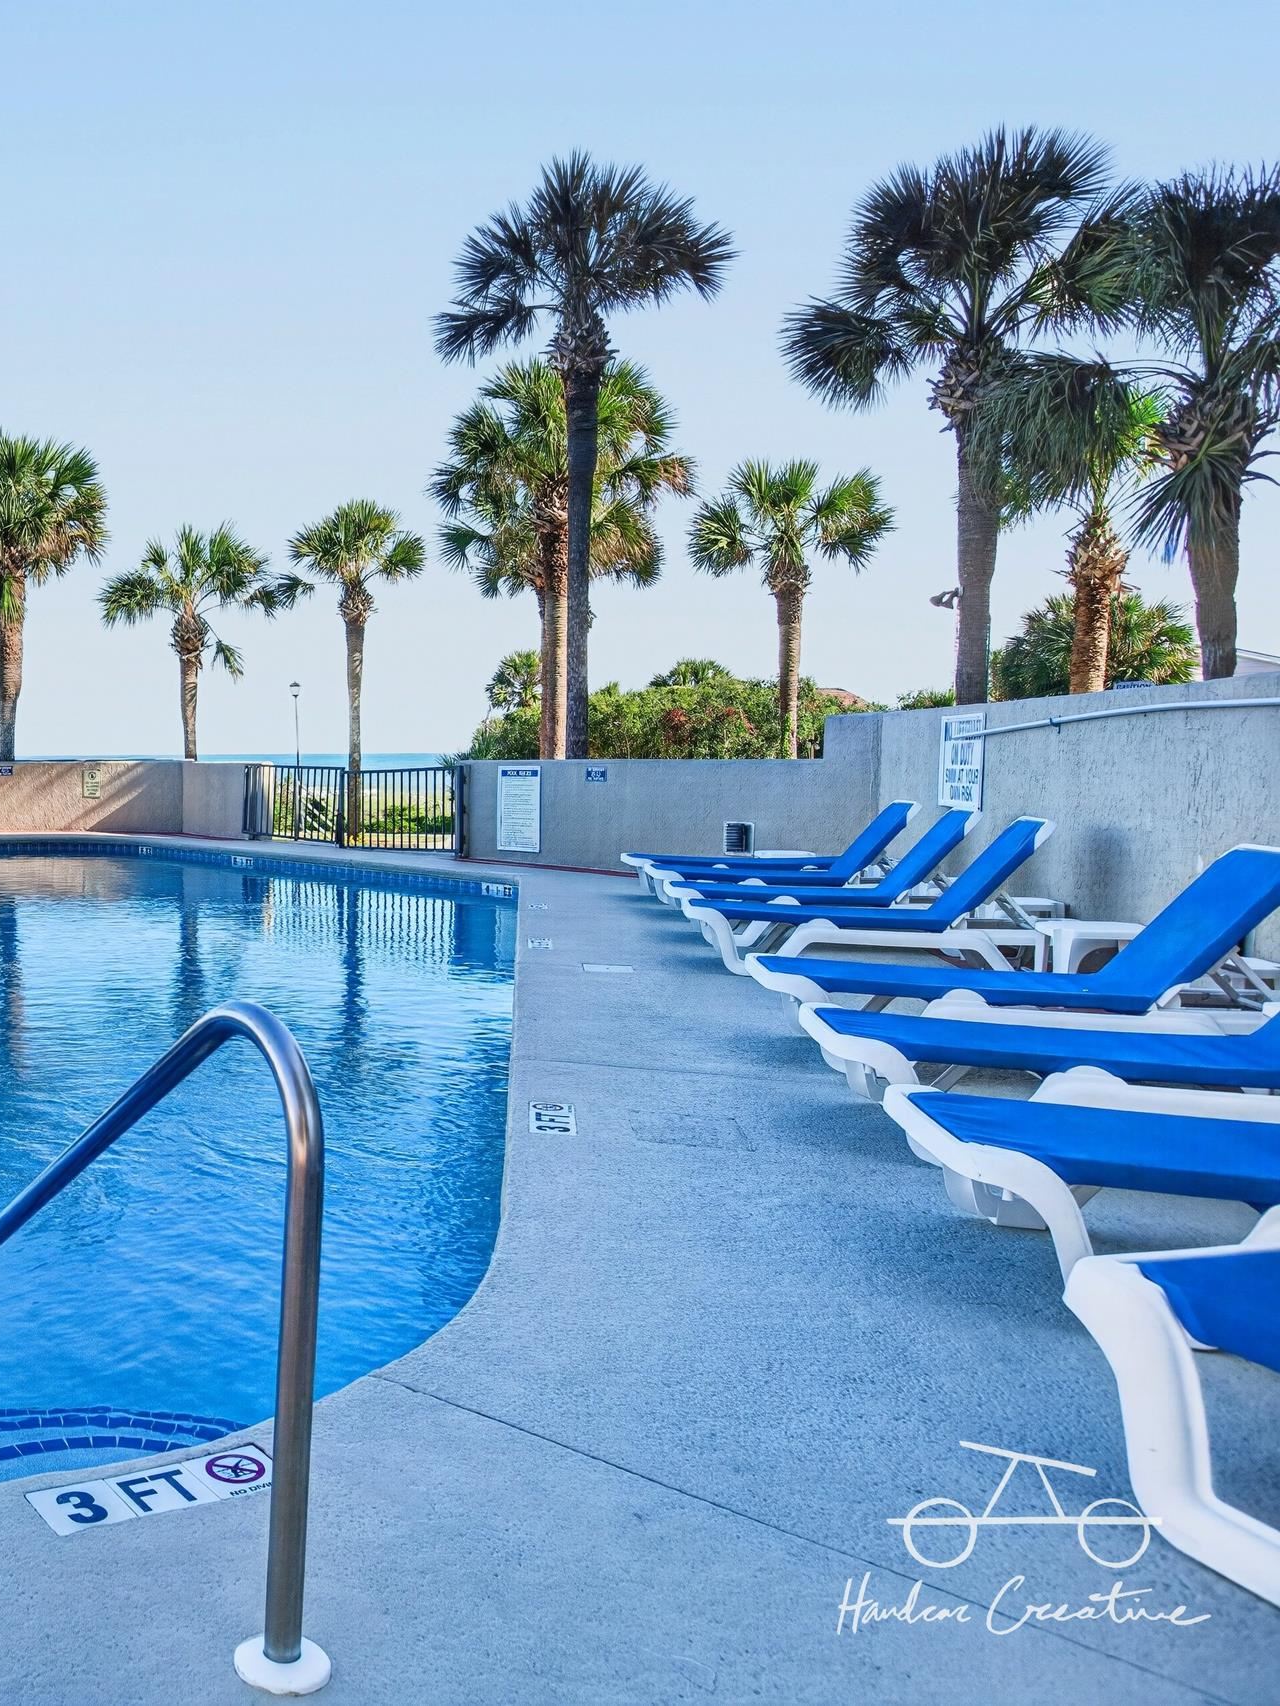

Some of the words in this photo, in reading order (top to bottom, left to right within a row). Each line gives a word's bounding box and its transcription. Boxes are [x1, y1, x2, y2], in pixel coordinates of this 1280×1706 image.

[961, 785, 973, 802] RISK
[535, 1111, 570, 1124] FT
[535, 1125, 571, 1133] 3
[56, 1491, 109, 1524] 3
[116, 1469, 198, 1513] FT
[230, 1489, 247, 1497] NO
[248, 1481, 272, 1492] DIVI
